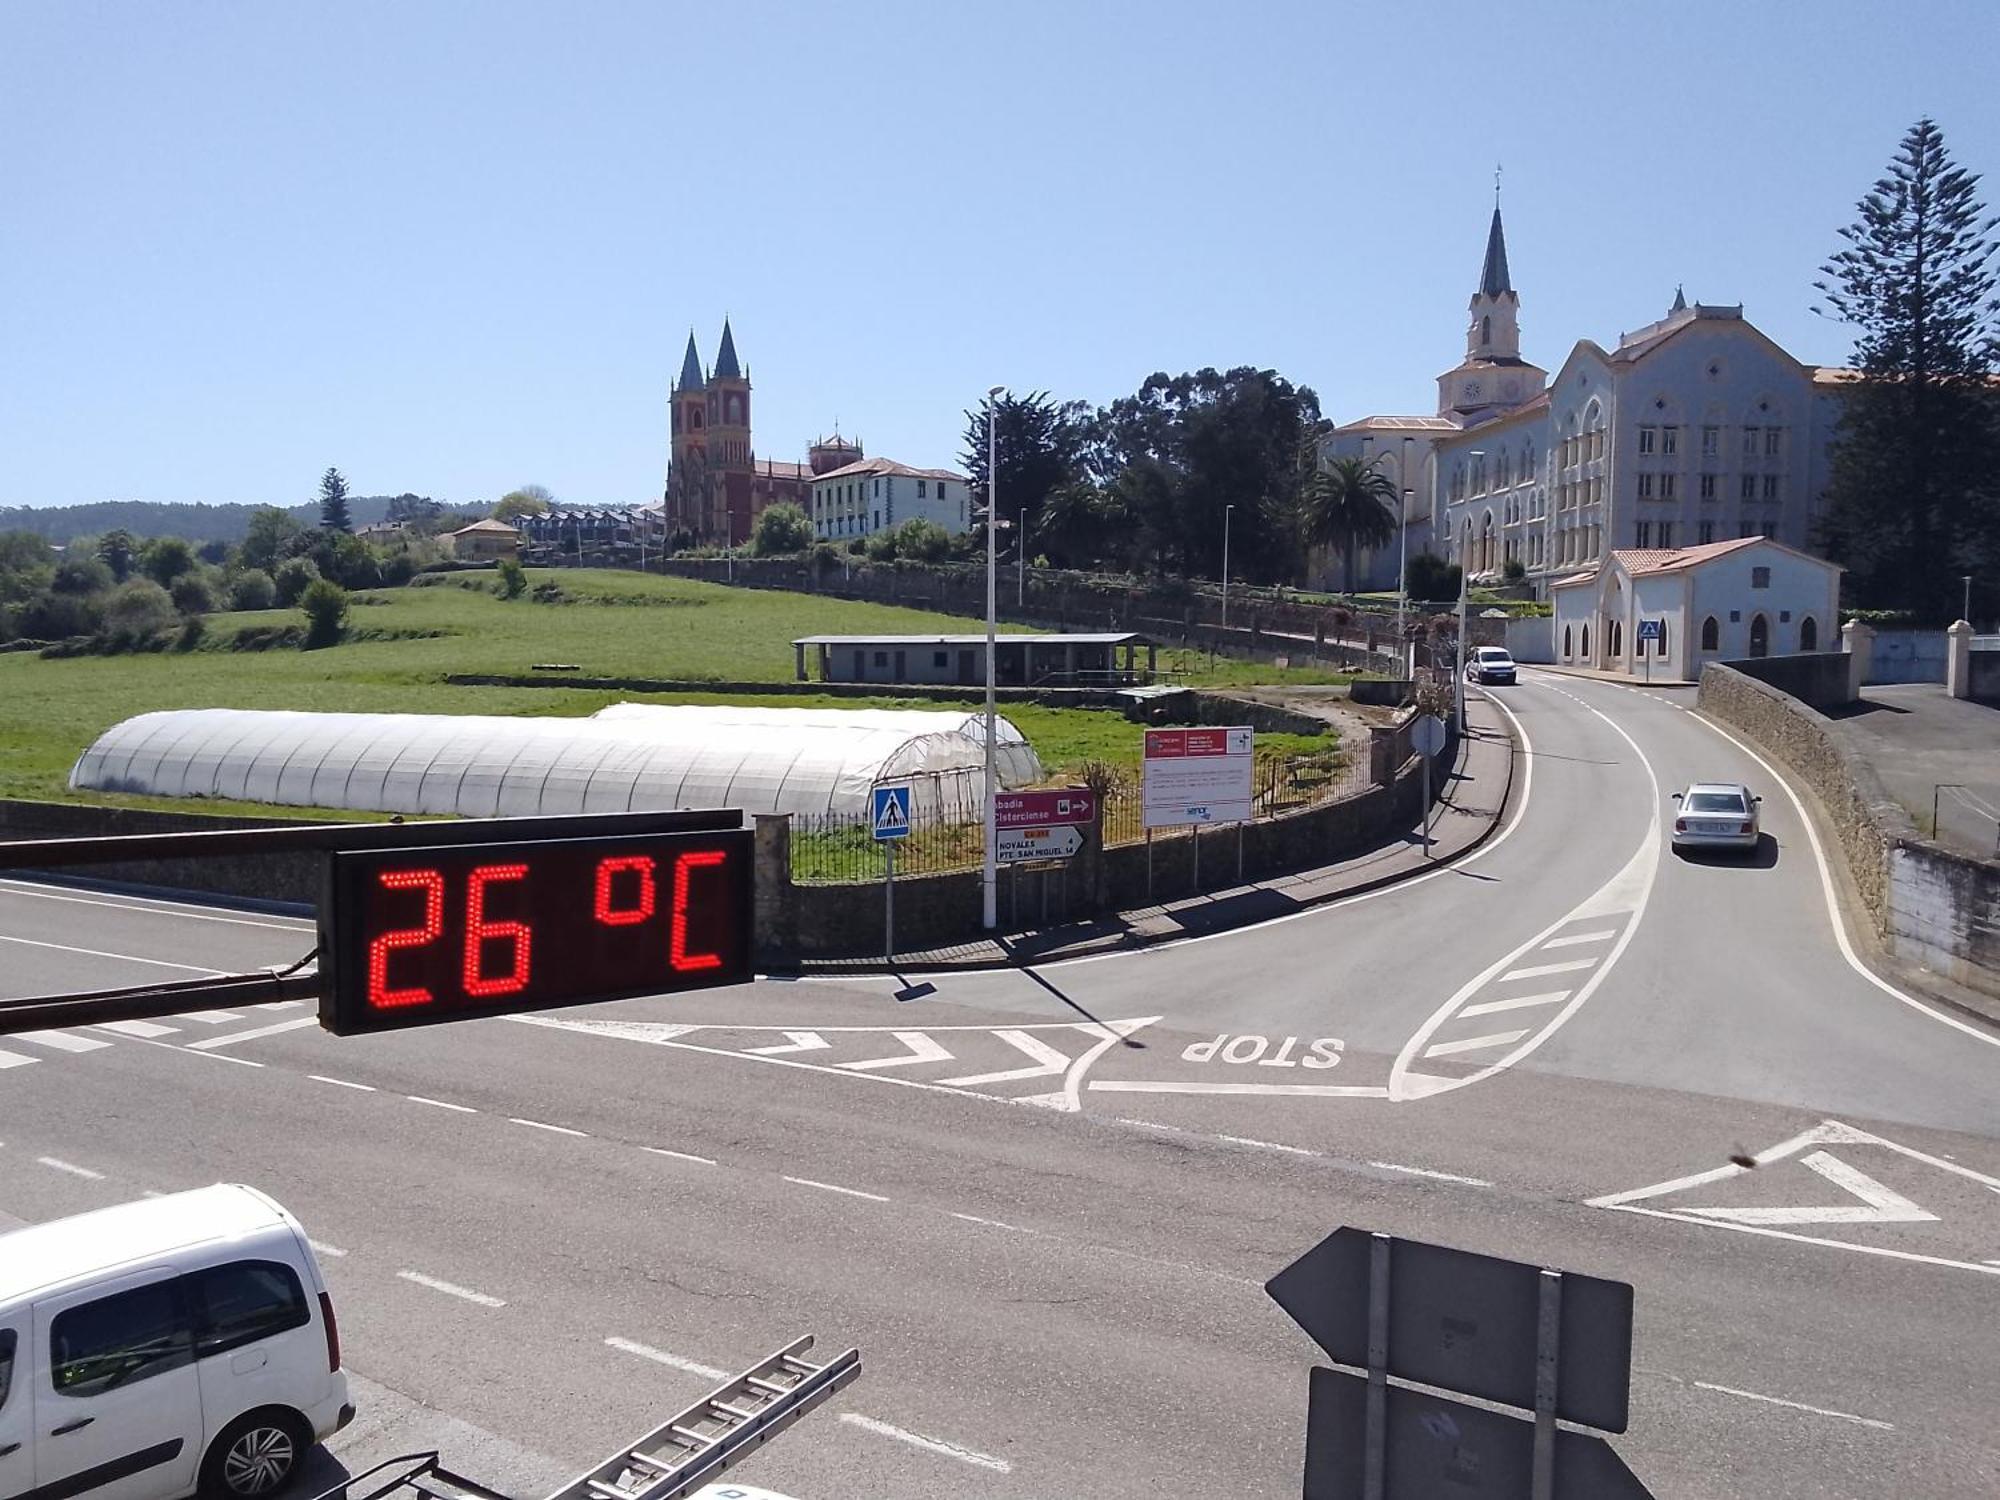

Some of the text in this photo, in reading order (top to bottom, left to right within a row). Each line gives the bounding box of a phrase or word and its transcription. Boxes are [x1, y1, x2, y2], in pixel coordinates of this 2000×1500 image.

[1000, 841, 1035, 849] NOVALES
[1018, 849, 1034, 858] SAN
[1036, 848, 1061, 856] MIGUEL
[369, 864, 531, 1008] 26
[1181, 1034, 1345, 1069] STOP
